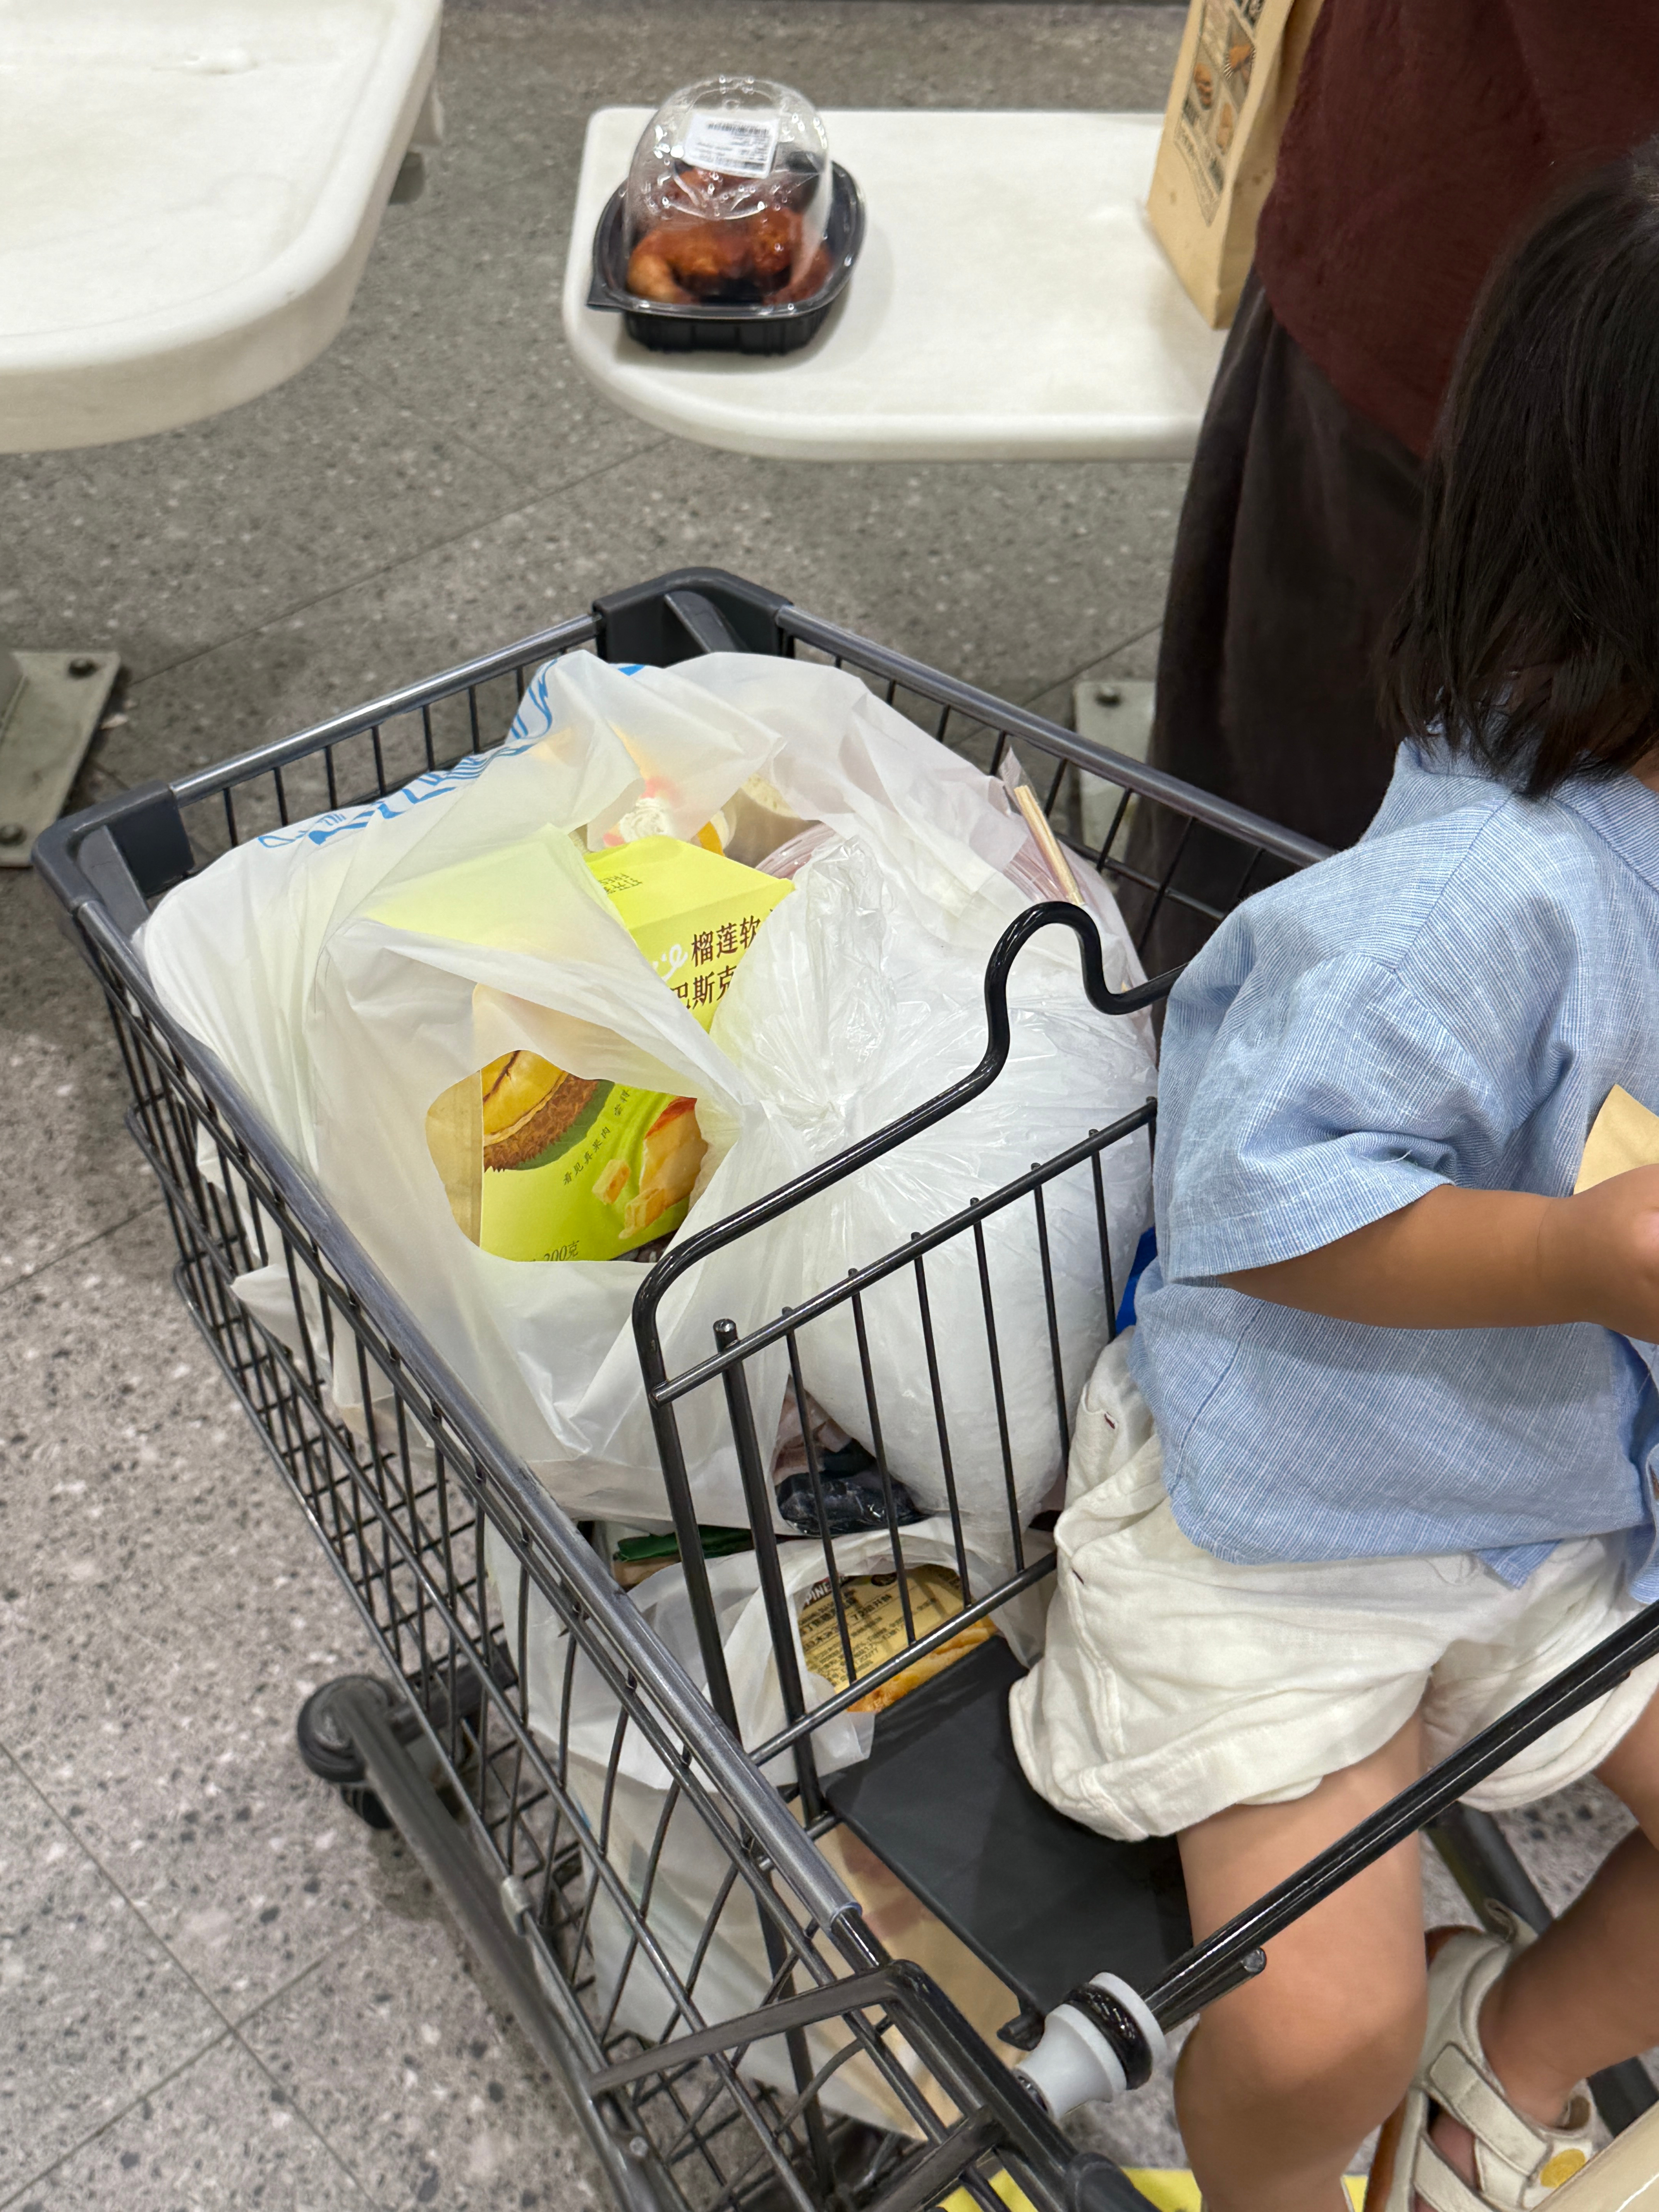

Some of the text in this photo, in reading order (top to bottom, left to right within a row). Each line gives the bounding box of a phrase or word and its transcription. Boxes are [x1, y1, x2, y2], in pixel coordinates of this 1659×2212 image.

[691, 915, 762, 967] 榴莲软
[670, 965, 737, 1010] 巴斯克
[563, 1127, 611, 1186] 看见真果肉
